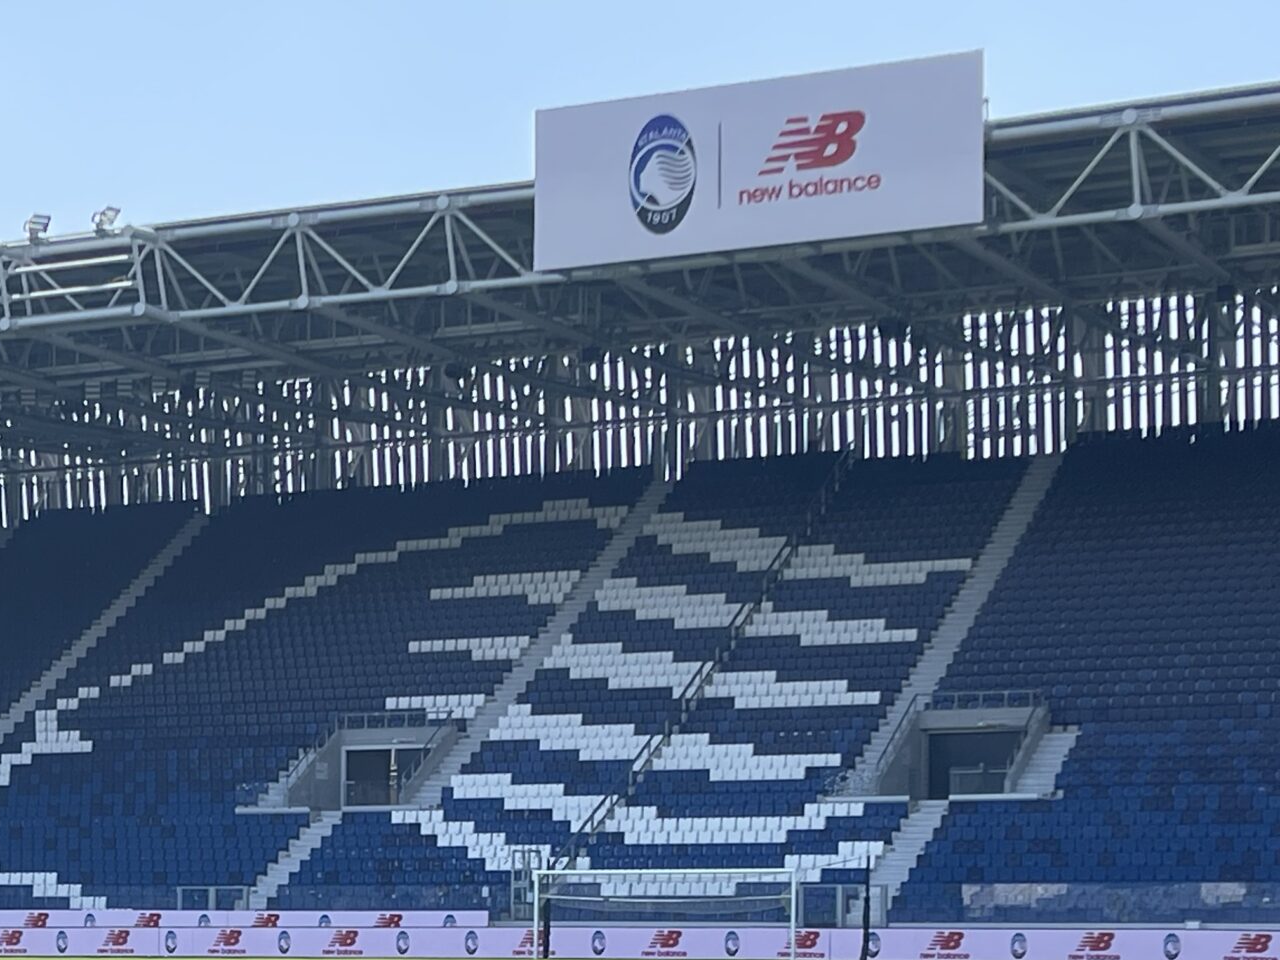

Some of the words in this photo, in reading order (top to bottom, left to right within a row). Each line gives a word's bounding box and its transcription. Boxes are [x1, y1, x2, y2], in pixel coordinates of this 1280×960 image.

[758, 110, 866, 176] NB
[738, 185, 783, 205] new
[788, 174, 882, 199] balance
[646, 208, 678, 225] 1907
